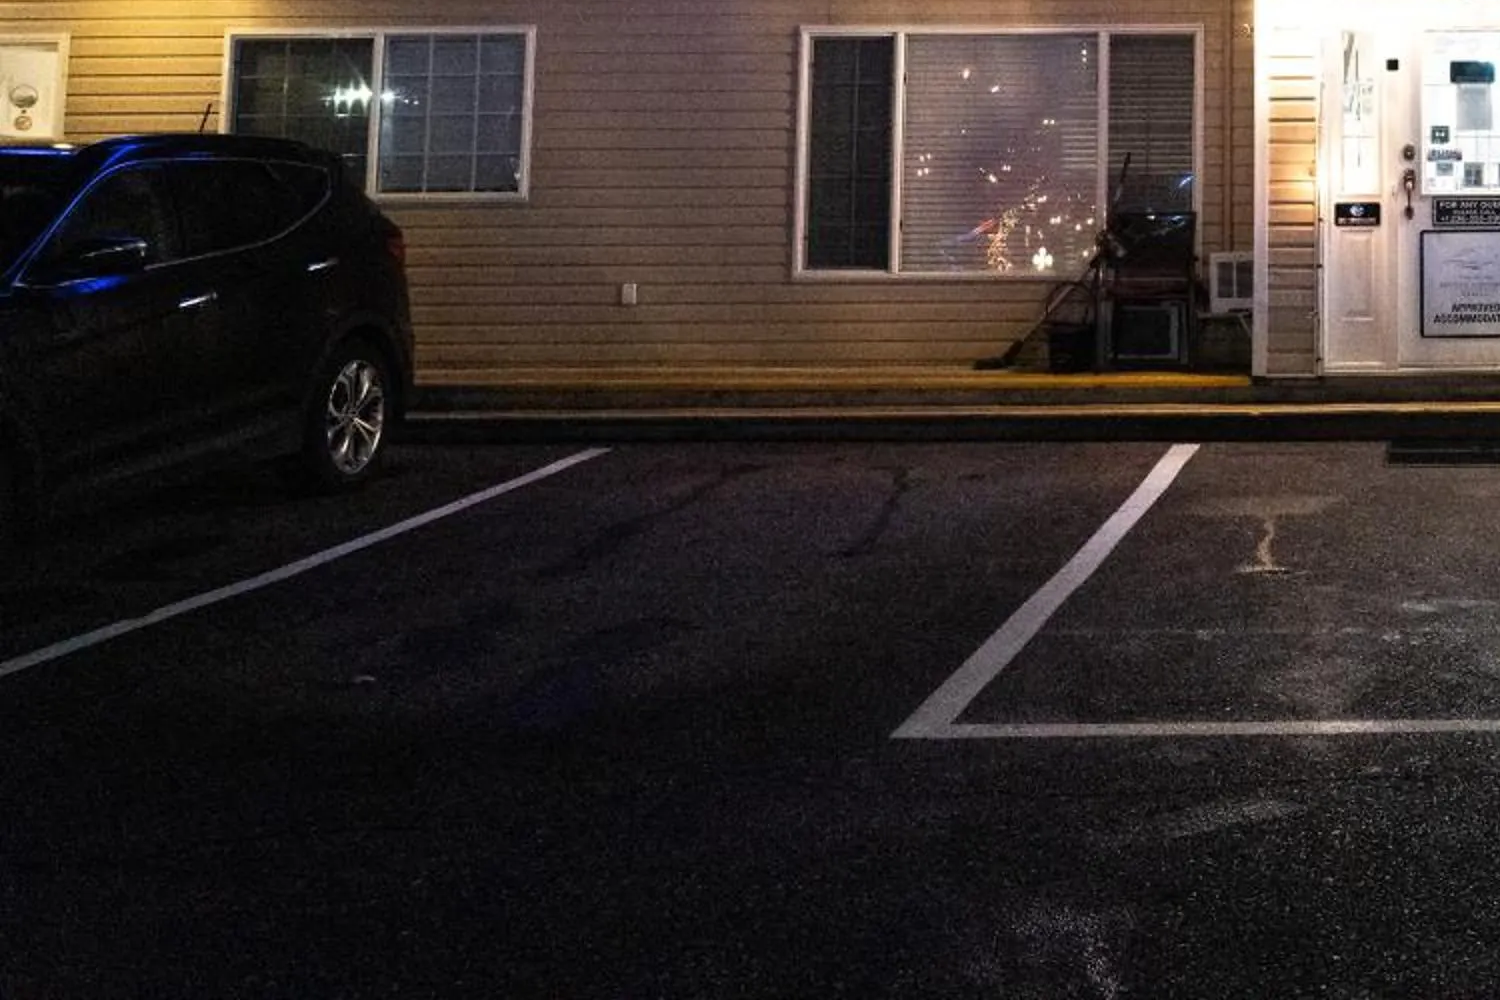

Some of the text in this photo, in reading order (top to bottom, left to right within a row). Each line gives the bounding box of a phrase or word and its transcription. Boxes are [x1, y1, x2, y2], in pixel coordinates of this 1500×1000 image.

[1439, 201, 1457, 209] FOR
[1460, 201, 1478, 209] ANY
[1451, 303, 1500, 313] APPROVED
